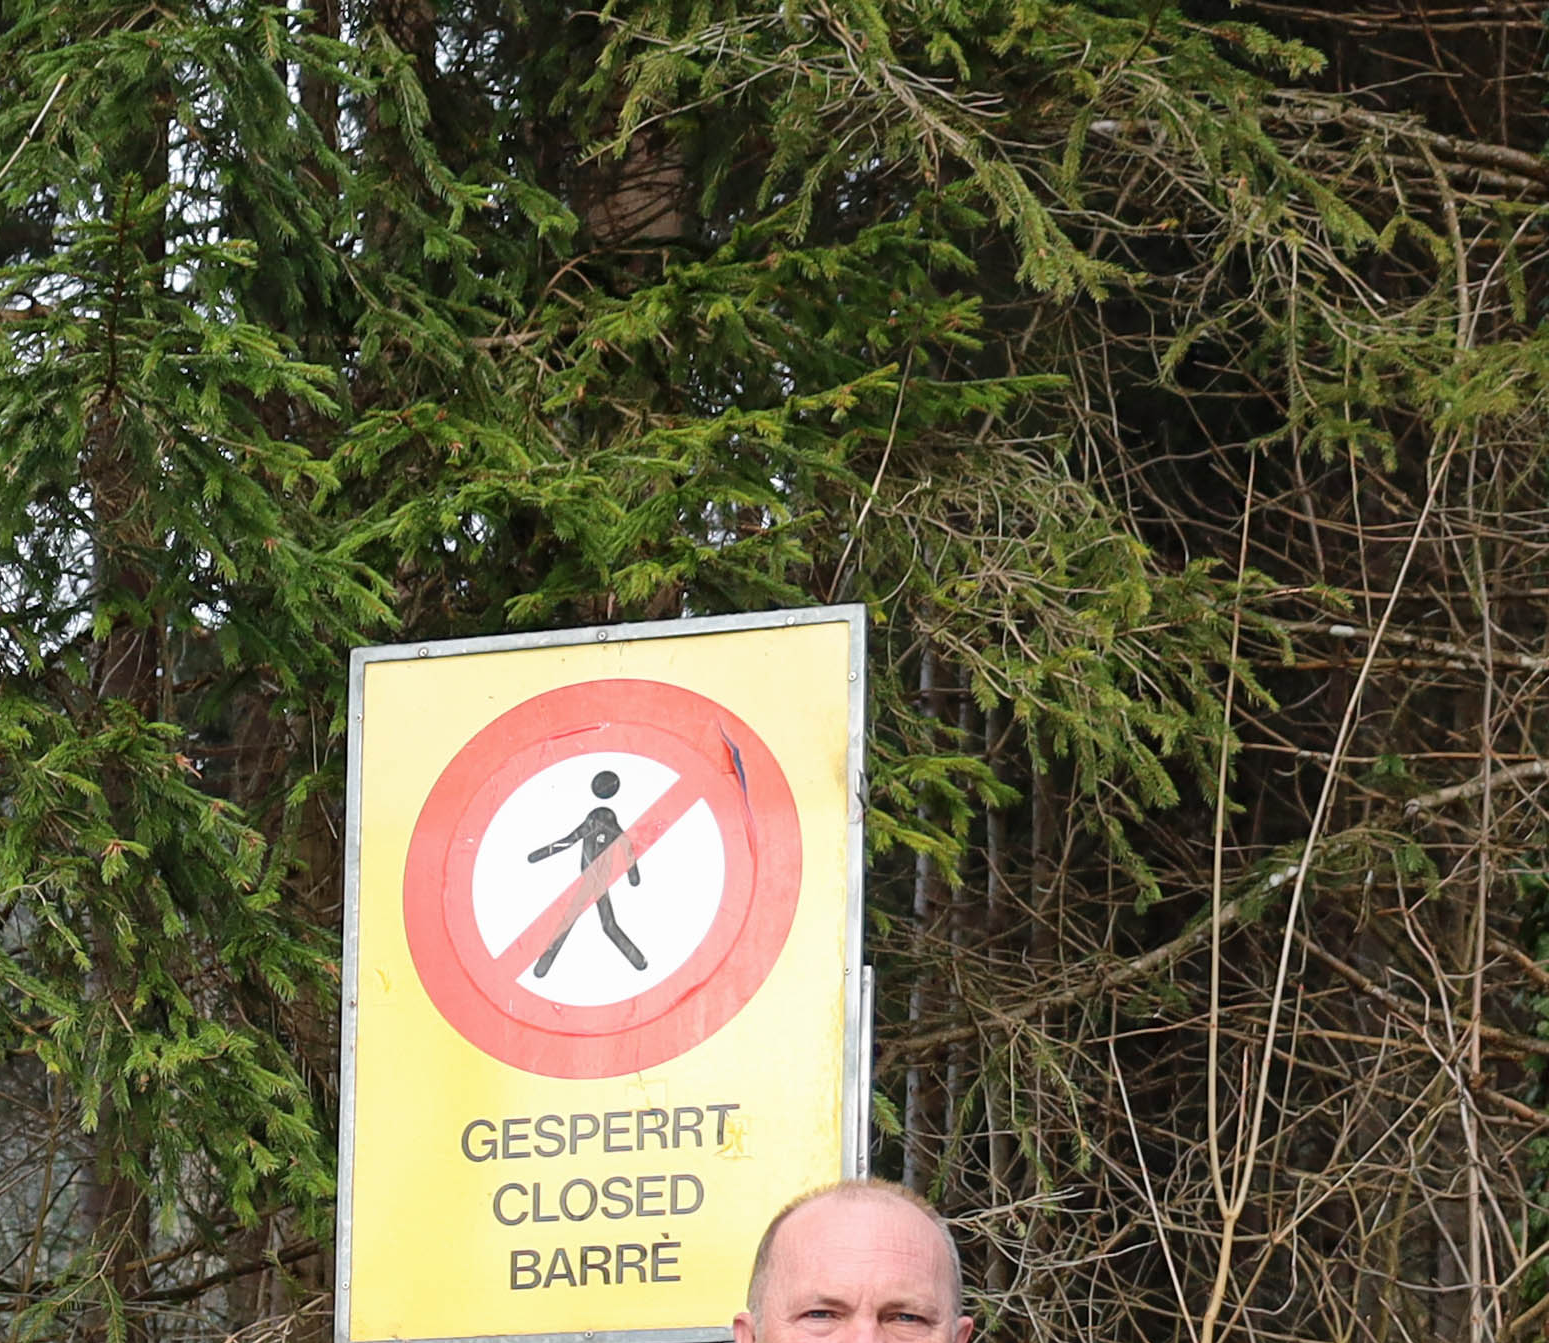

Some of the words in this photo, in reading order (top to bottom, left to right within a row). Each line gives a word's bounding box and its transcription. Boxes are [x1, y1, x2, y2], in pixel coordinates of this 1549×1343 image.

[461, 1103, 741, 1163] GESPERRT
[492, 1173, 705, 1227] CLOSED
[509, 1231, 682, 1291] BARRÈ
